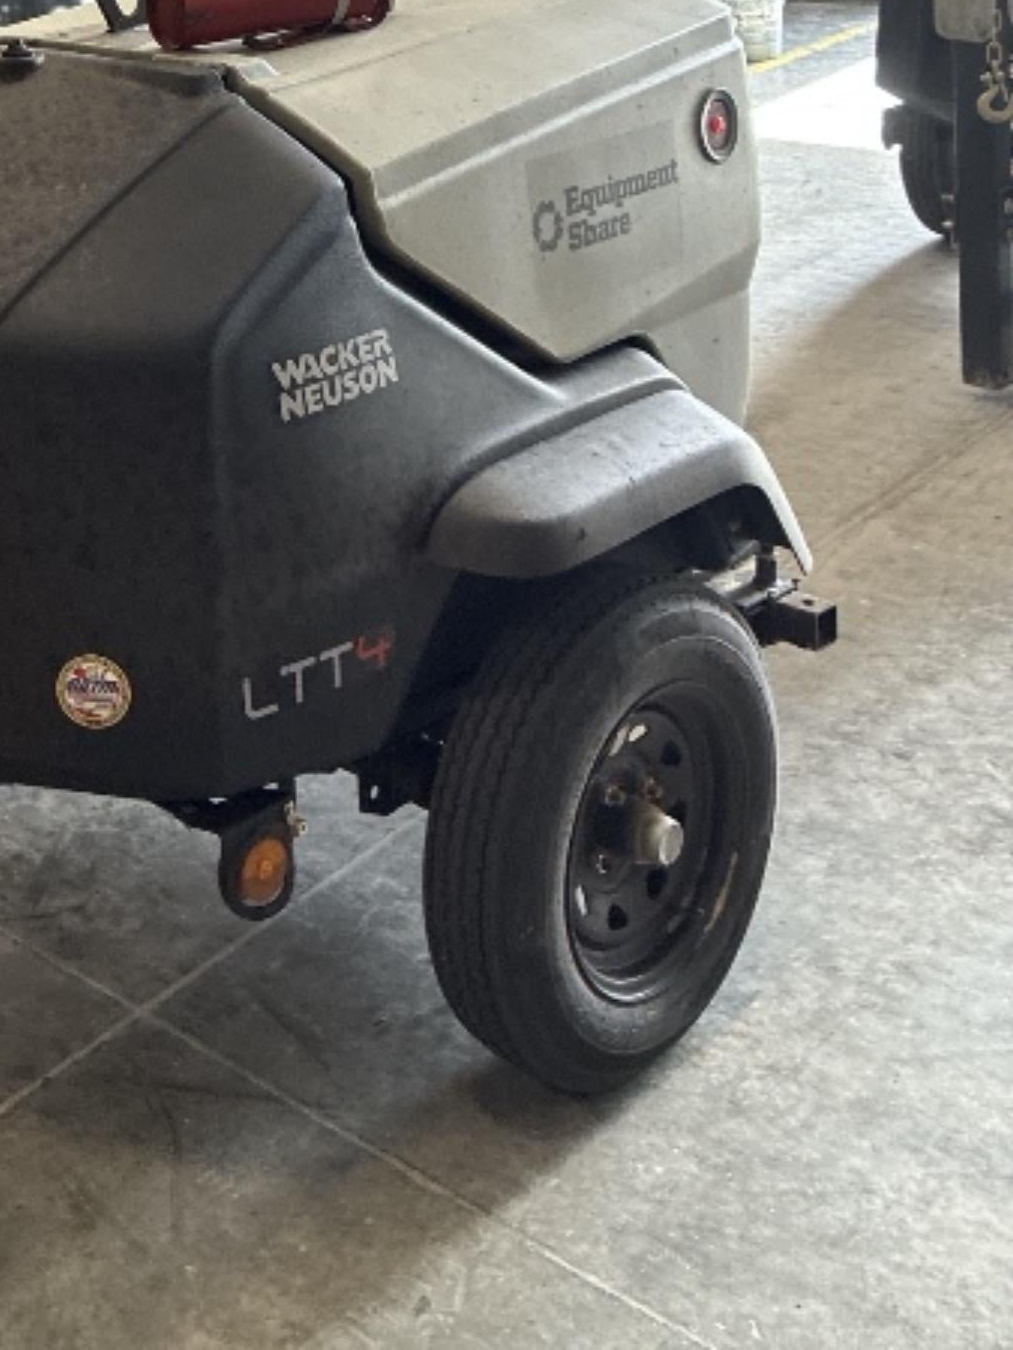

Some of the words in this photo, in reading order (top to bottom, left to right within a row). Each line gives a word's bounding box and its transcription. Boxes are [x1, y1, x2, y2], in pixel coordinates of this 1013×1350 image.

[564, 158, 679, 217] Equipment
[568, 212, 631, 252] Share
[271, 329, 393, 391] WACKER
[280, 355, 399, 424] NEUSON
